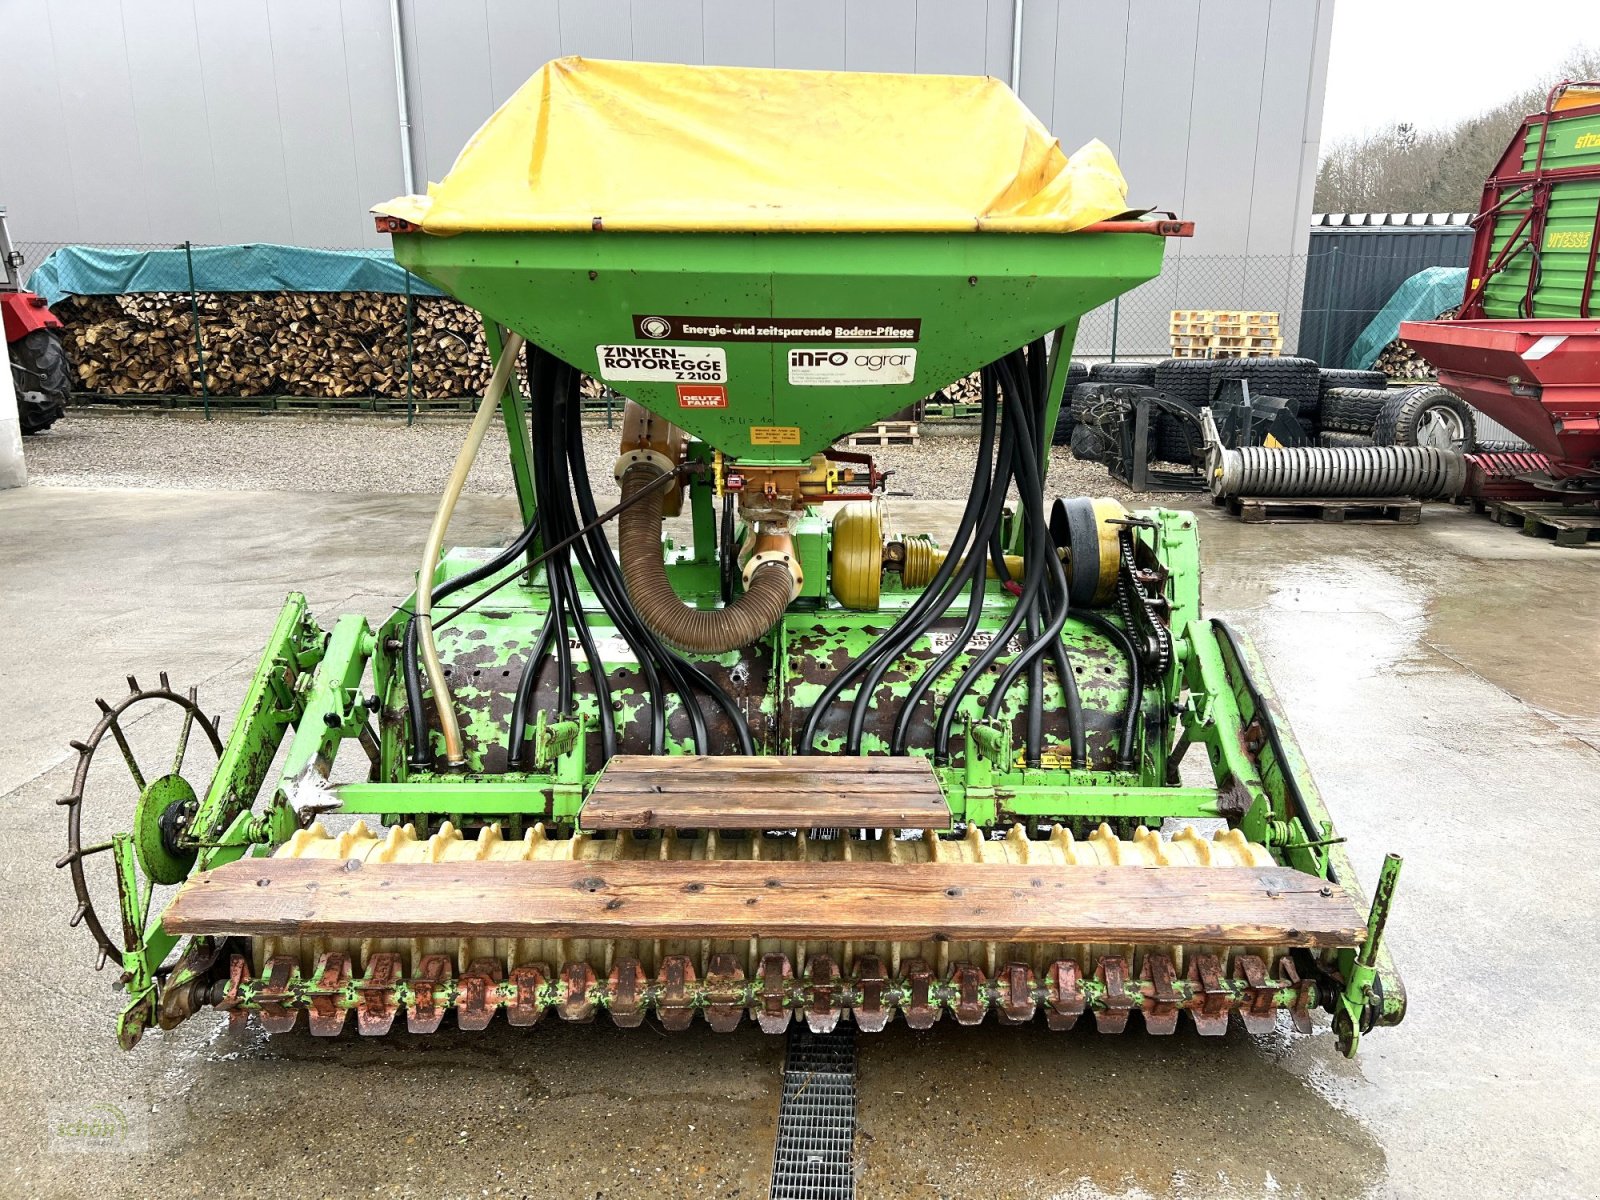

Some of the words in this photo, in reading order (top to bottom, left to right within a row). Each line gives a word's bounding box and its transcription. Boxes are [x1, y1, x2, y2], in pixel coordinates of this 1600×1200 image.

[1547, 231, 1591, 248] VITESSE
[757, 326, 832, 338] zeitsparende
[835, 326, 914, 338] Boden-Pflege
[603, 347, 686, 359] ZINKEN-
[604, 358, 721, 371] ROTOREGGE
[855, 354, 911, 371] agrar
[675, 372, 685, 380] Z
[687, 372, 721, 381] 2100
